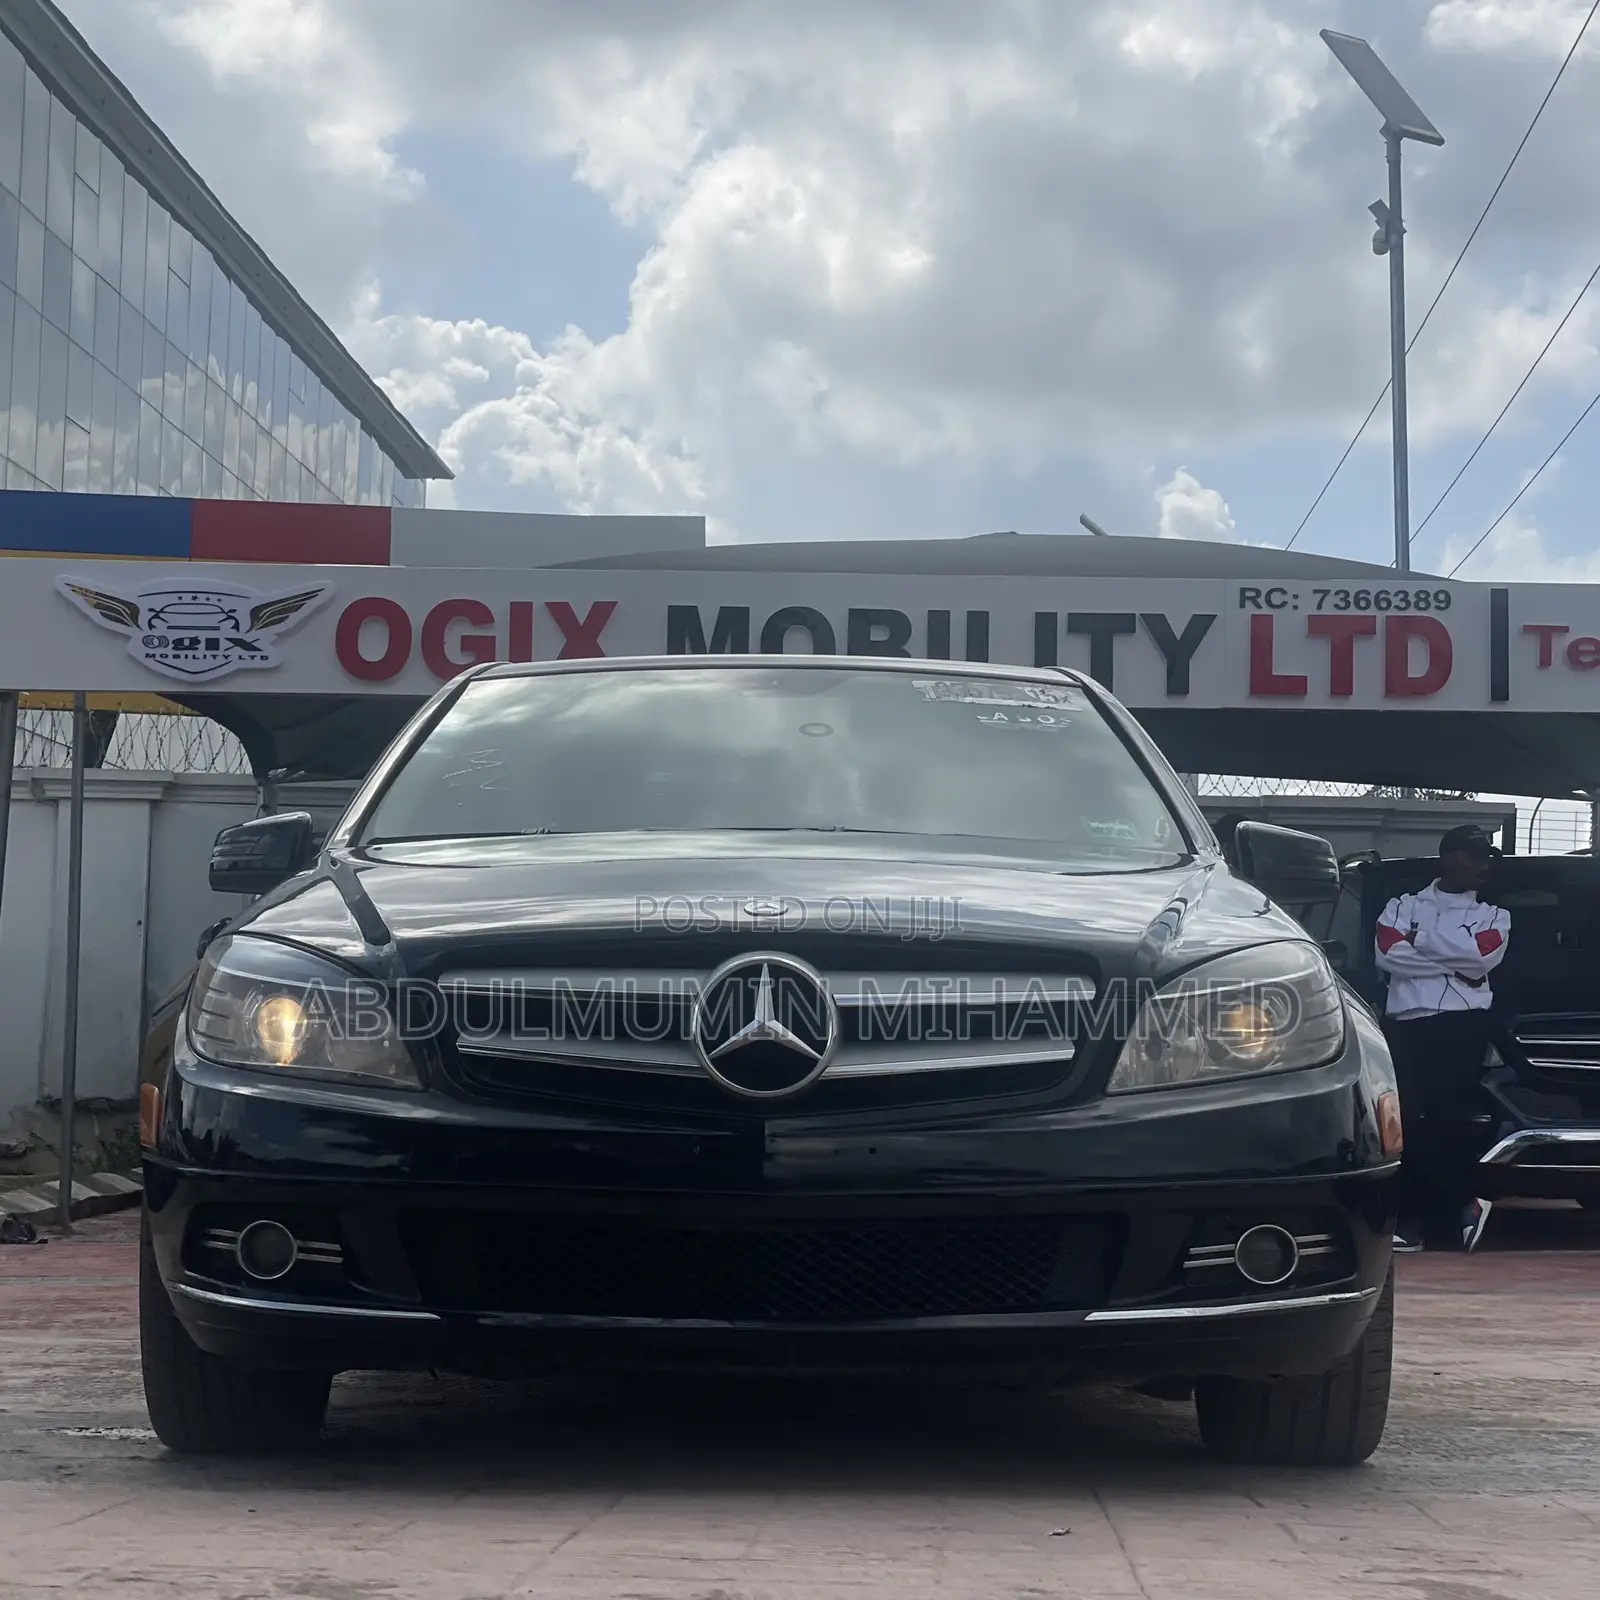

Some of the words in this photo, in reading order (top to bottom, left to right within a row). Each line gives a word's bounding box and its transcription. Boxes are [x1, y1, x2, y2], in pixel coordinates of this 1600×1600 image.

[1239, 587, 1299, 610] RC:
[1312, 588, 1452, 612] 7366389
[144, 652, 232, 661] MOBILITY
[238, 654, 270, 662] LTD
[335, 596, 618, 682] OGIX
[1250, 613, 1453, 697] LTD
